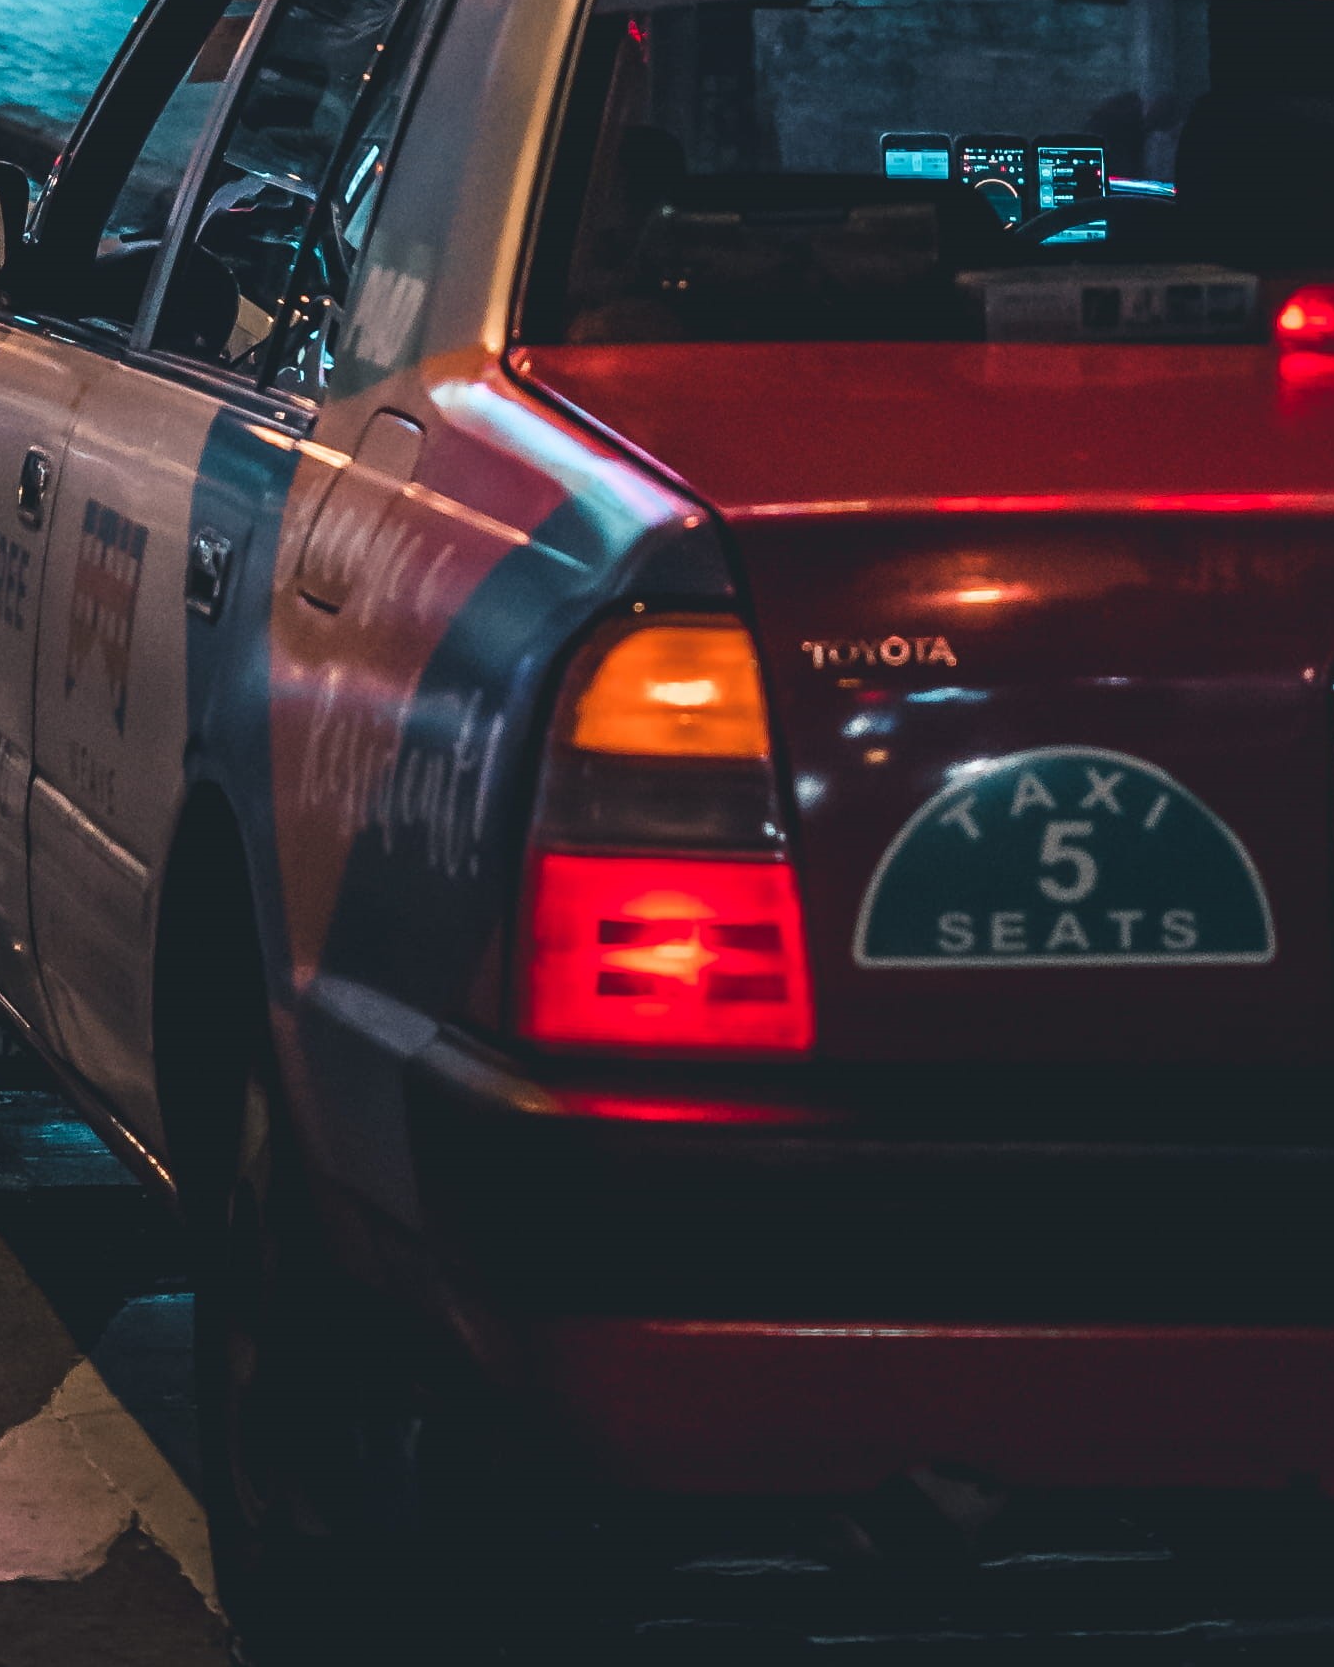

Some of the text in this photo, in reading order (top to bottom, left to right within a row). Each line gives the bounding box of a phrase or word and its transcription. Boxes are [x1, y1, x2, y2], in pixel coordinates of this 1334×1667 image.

[801, 635, 957, 668] TOYOTA
[940, 766, 1171, 842] TAXI
[1036, 819, 1099, 903] 5
[937, 909, 1199, 952] SEATS
